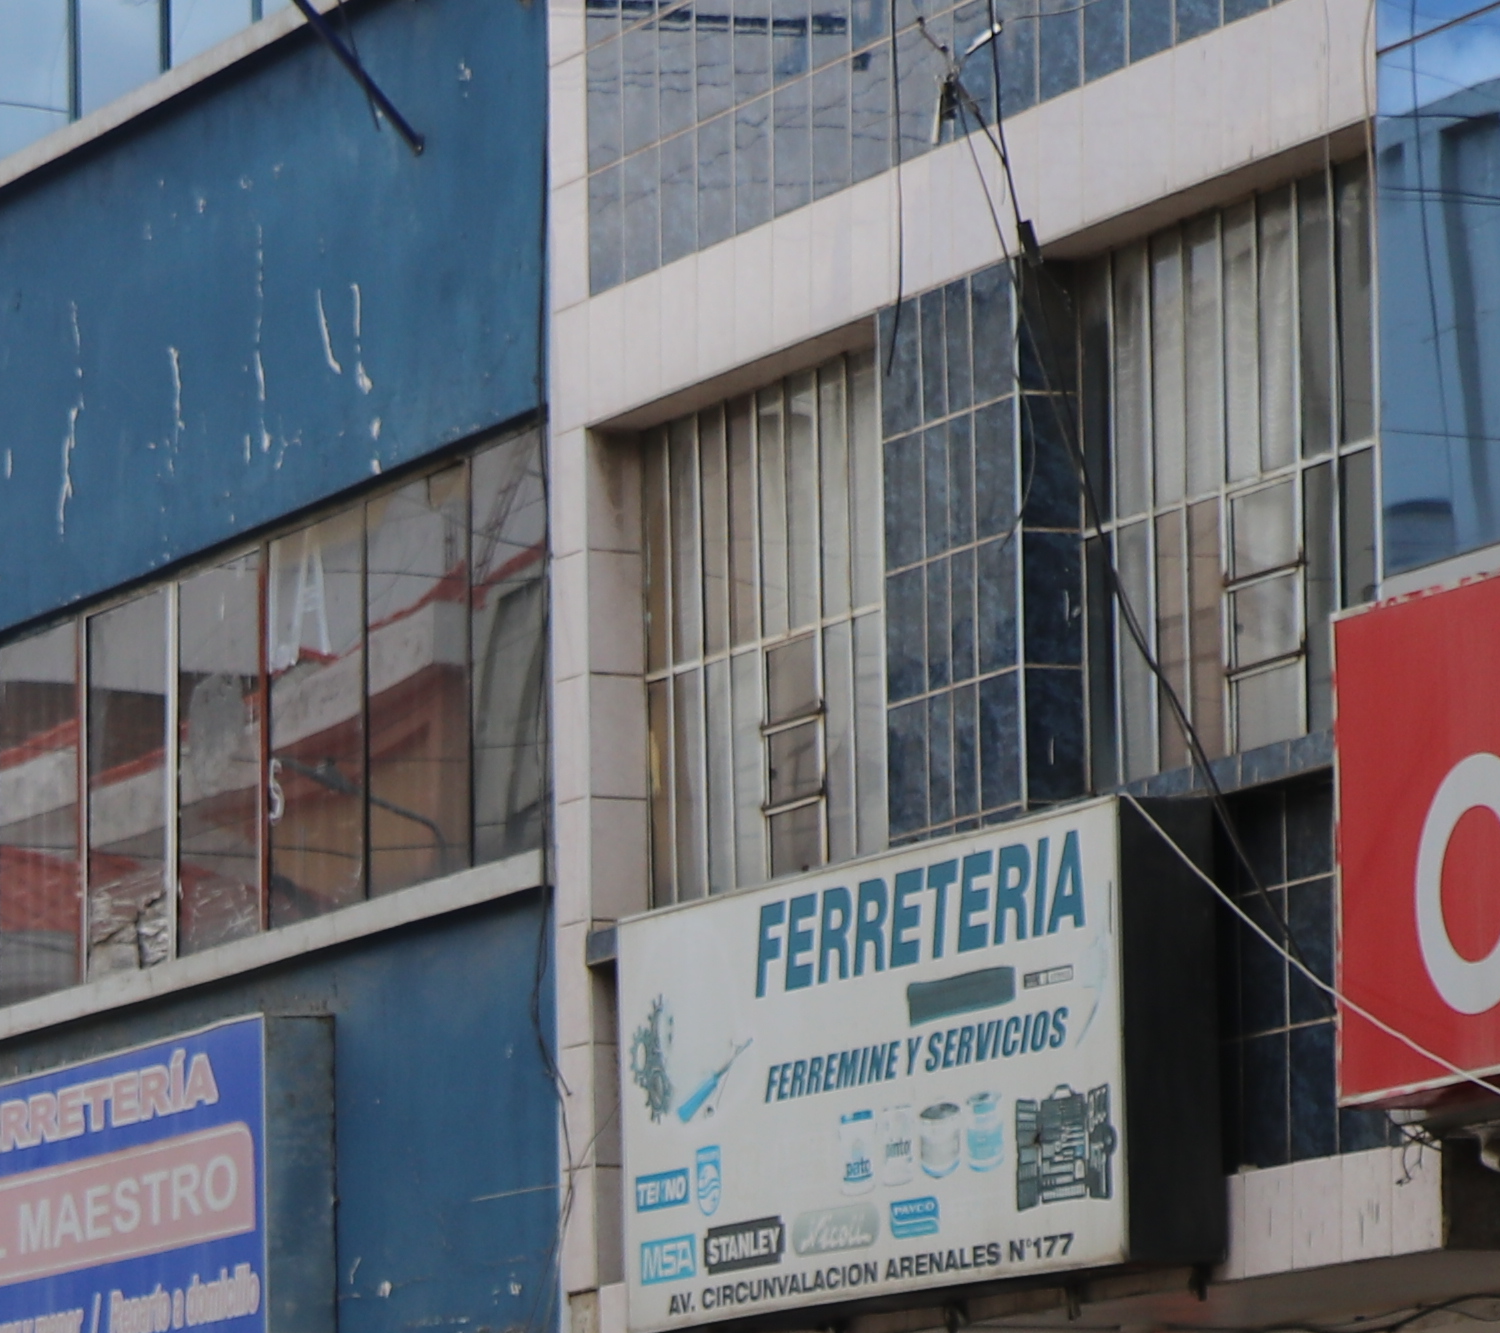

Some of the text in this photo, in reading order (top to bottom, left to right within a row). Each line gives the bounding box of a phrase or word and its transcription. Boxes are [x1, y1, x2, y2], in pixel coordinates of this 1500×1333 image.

[755, 828, 1087, 999] FERRETERIA
[764, 1005, 1071, 1104] FERREMINE Y SERVICIOS
[18, 1154, 239, 1256] MAESTRO
[707, 1225, 783, 1266] STANLEY
[642, 1238, 696, 1284] MSA
[667, 1292, 698, 1319] AV.
[701, 1261, 880, 1312] CIRCUNVALACION
[884, 1240, 1003, 1282] ARENALES
